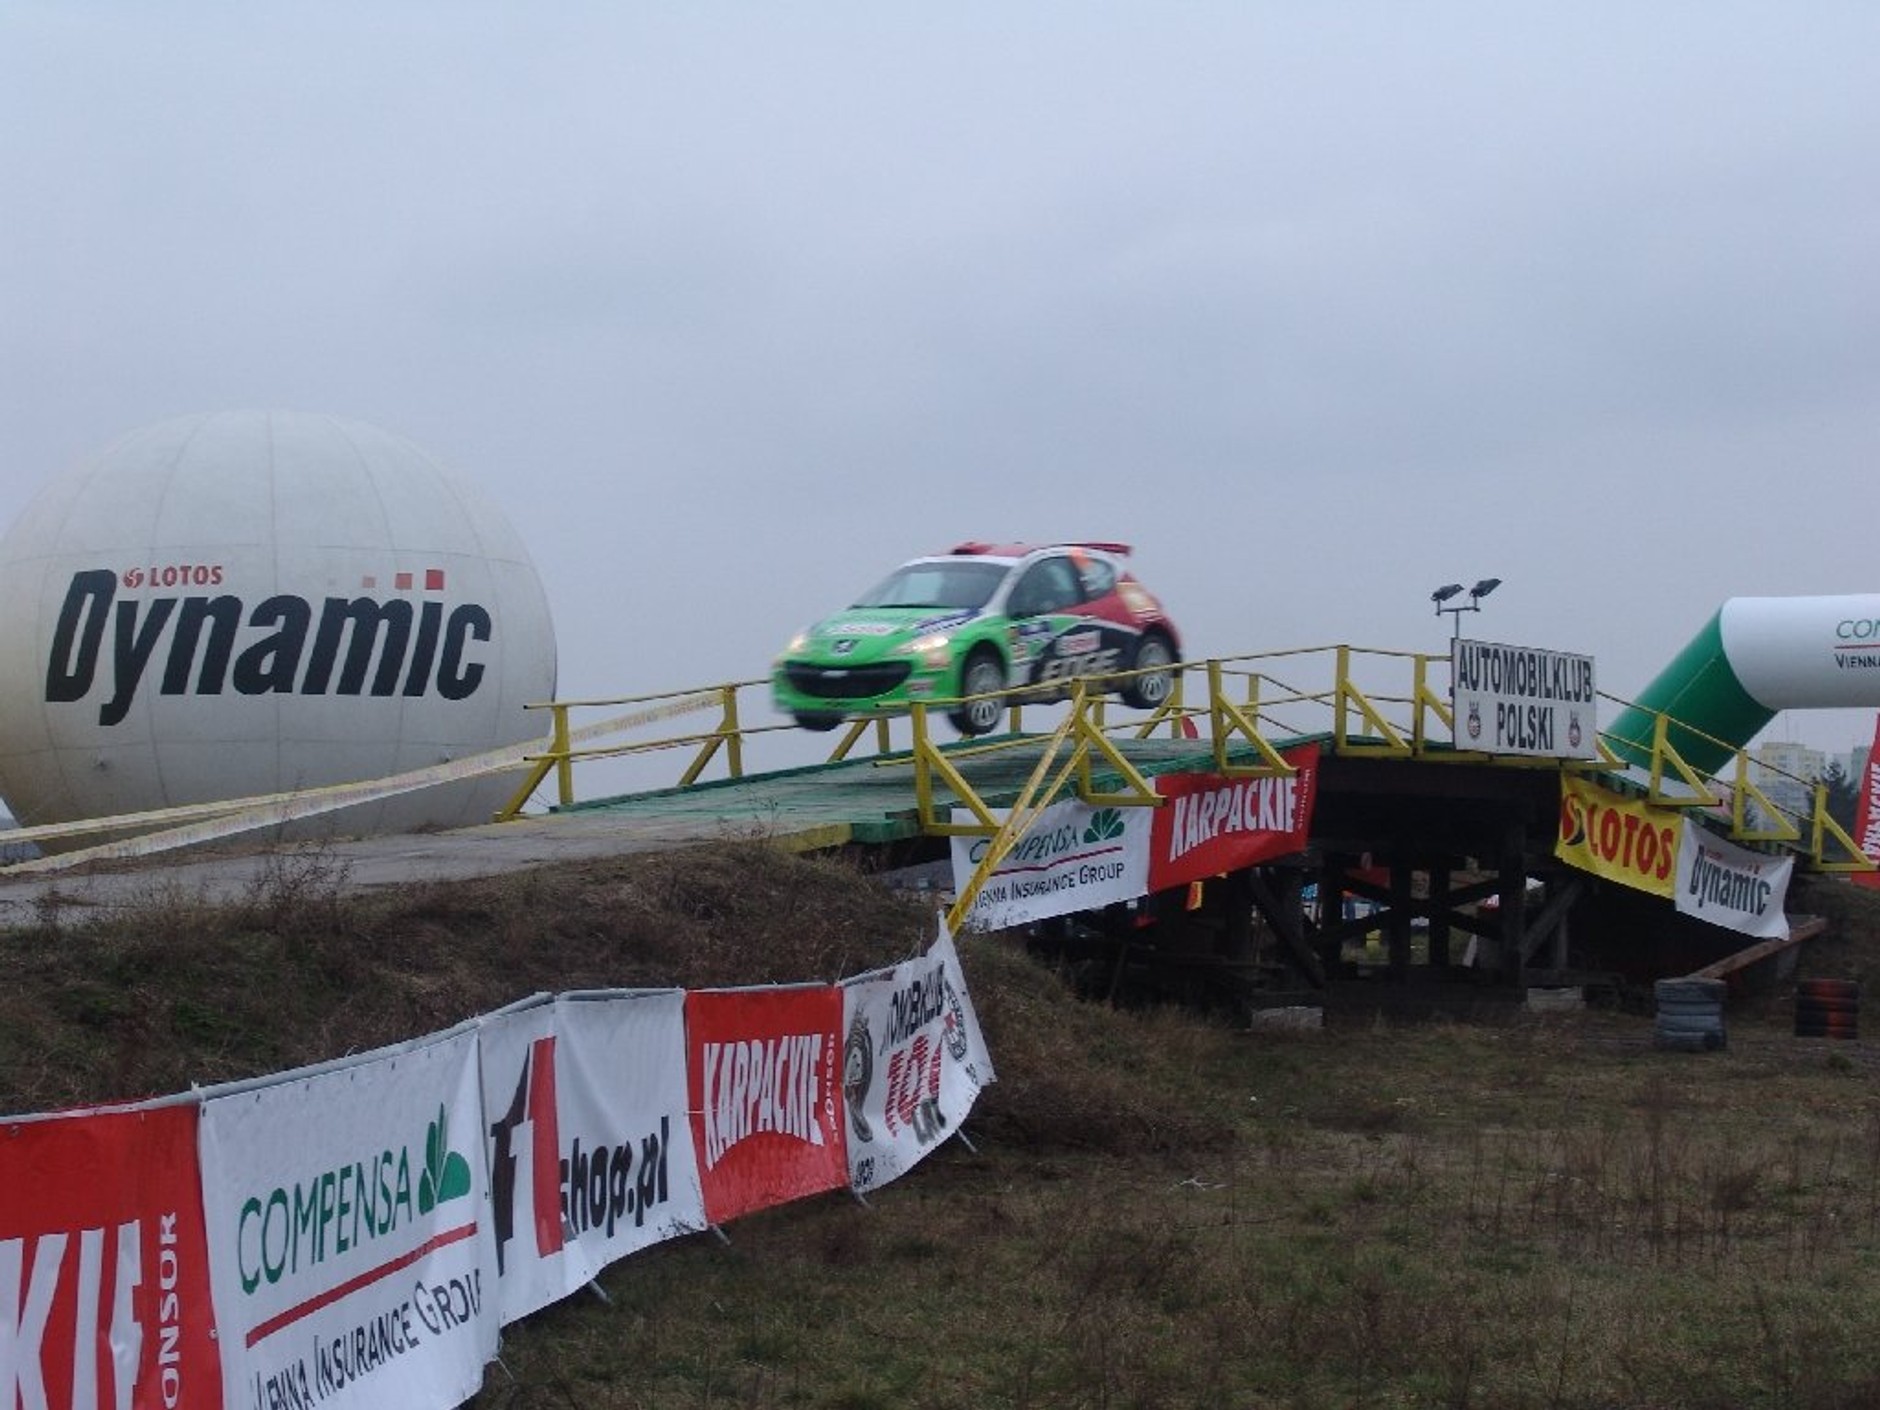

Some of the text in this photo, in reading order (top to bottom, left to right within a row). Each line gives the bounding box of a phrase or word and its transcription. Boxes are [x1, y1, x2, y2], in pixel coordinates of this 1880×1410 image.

[149, 565, 222, 587] LOTOS
[45, 569, 491, 726] Dynamic
[1458, 645, 1593, 702] AUTOMOBILKLUB
[1834, 653, 1880, 668] VIENN
[1497, 702, 1554, 750] POLSKI
[969, 824, 1079, 864] CMPENSA
[1170, 777, 1297, 863] KARPACKIE
[1587, 802, 1675, 880] LOTOS
[1011, 872, 1076, 900] INSURANCE
[1079, 863, 1125, 885] GROUP
[1689, 844, 1771, 916] Dynamic
[703, 1033, 825, 1173] KARPACKIE
[238, 1145, 413, 1296] COMPENSA
[314, 1302, 420, 1400] INSURANCE
[413, 1268, 481, 1335] GROU
